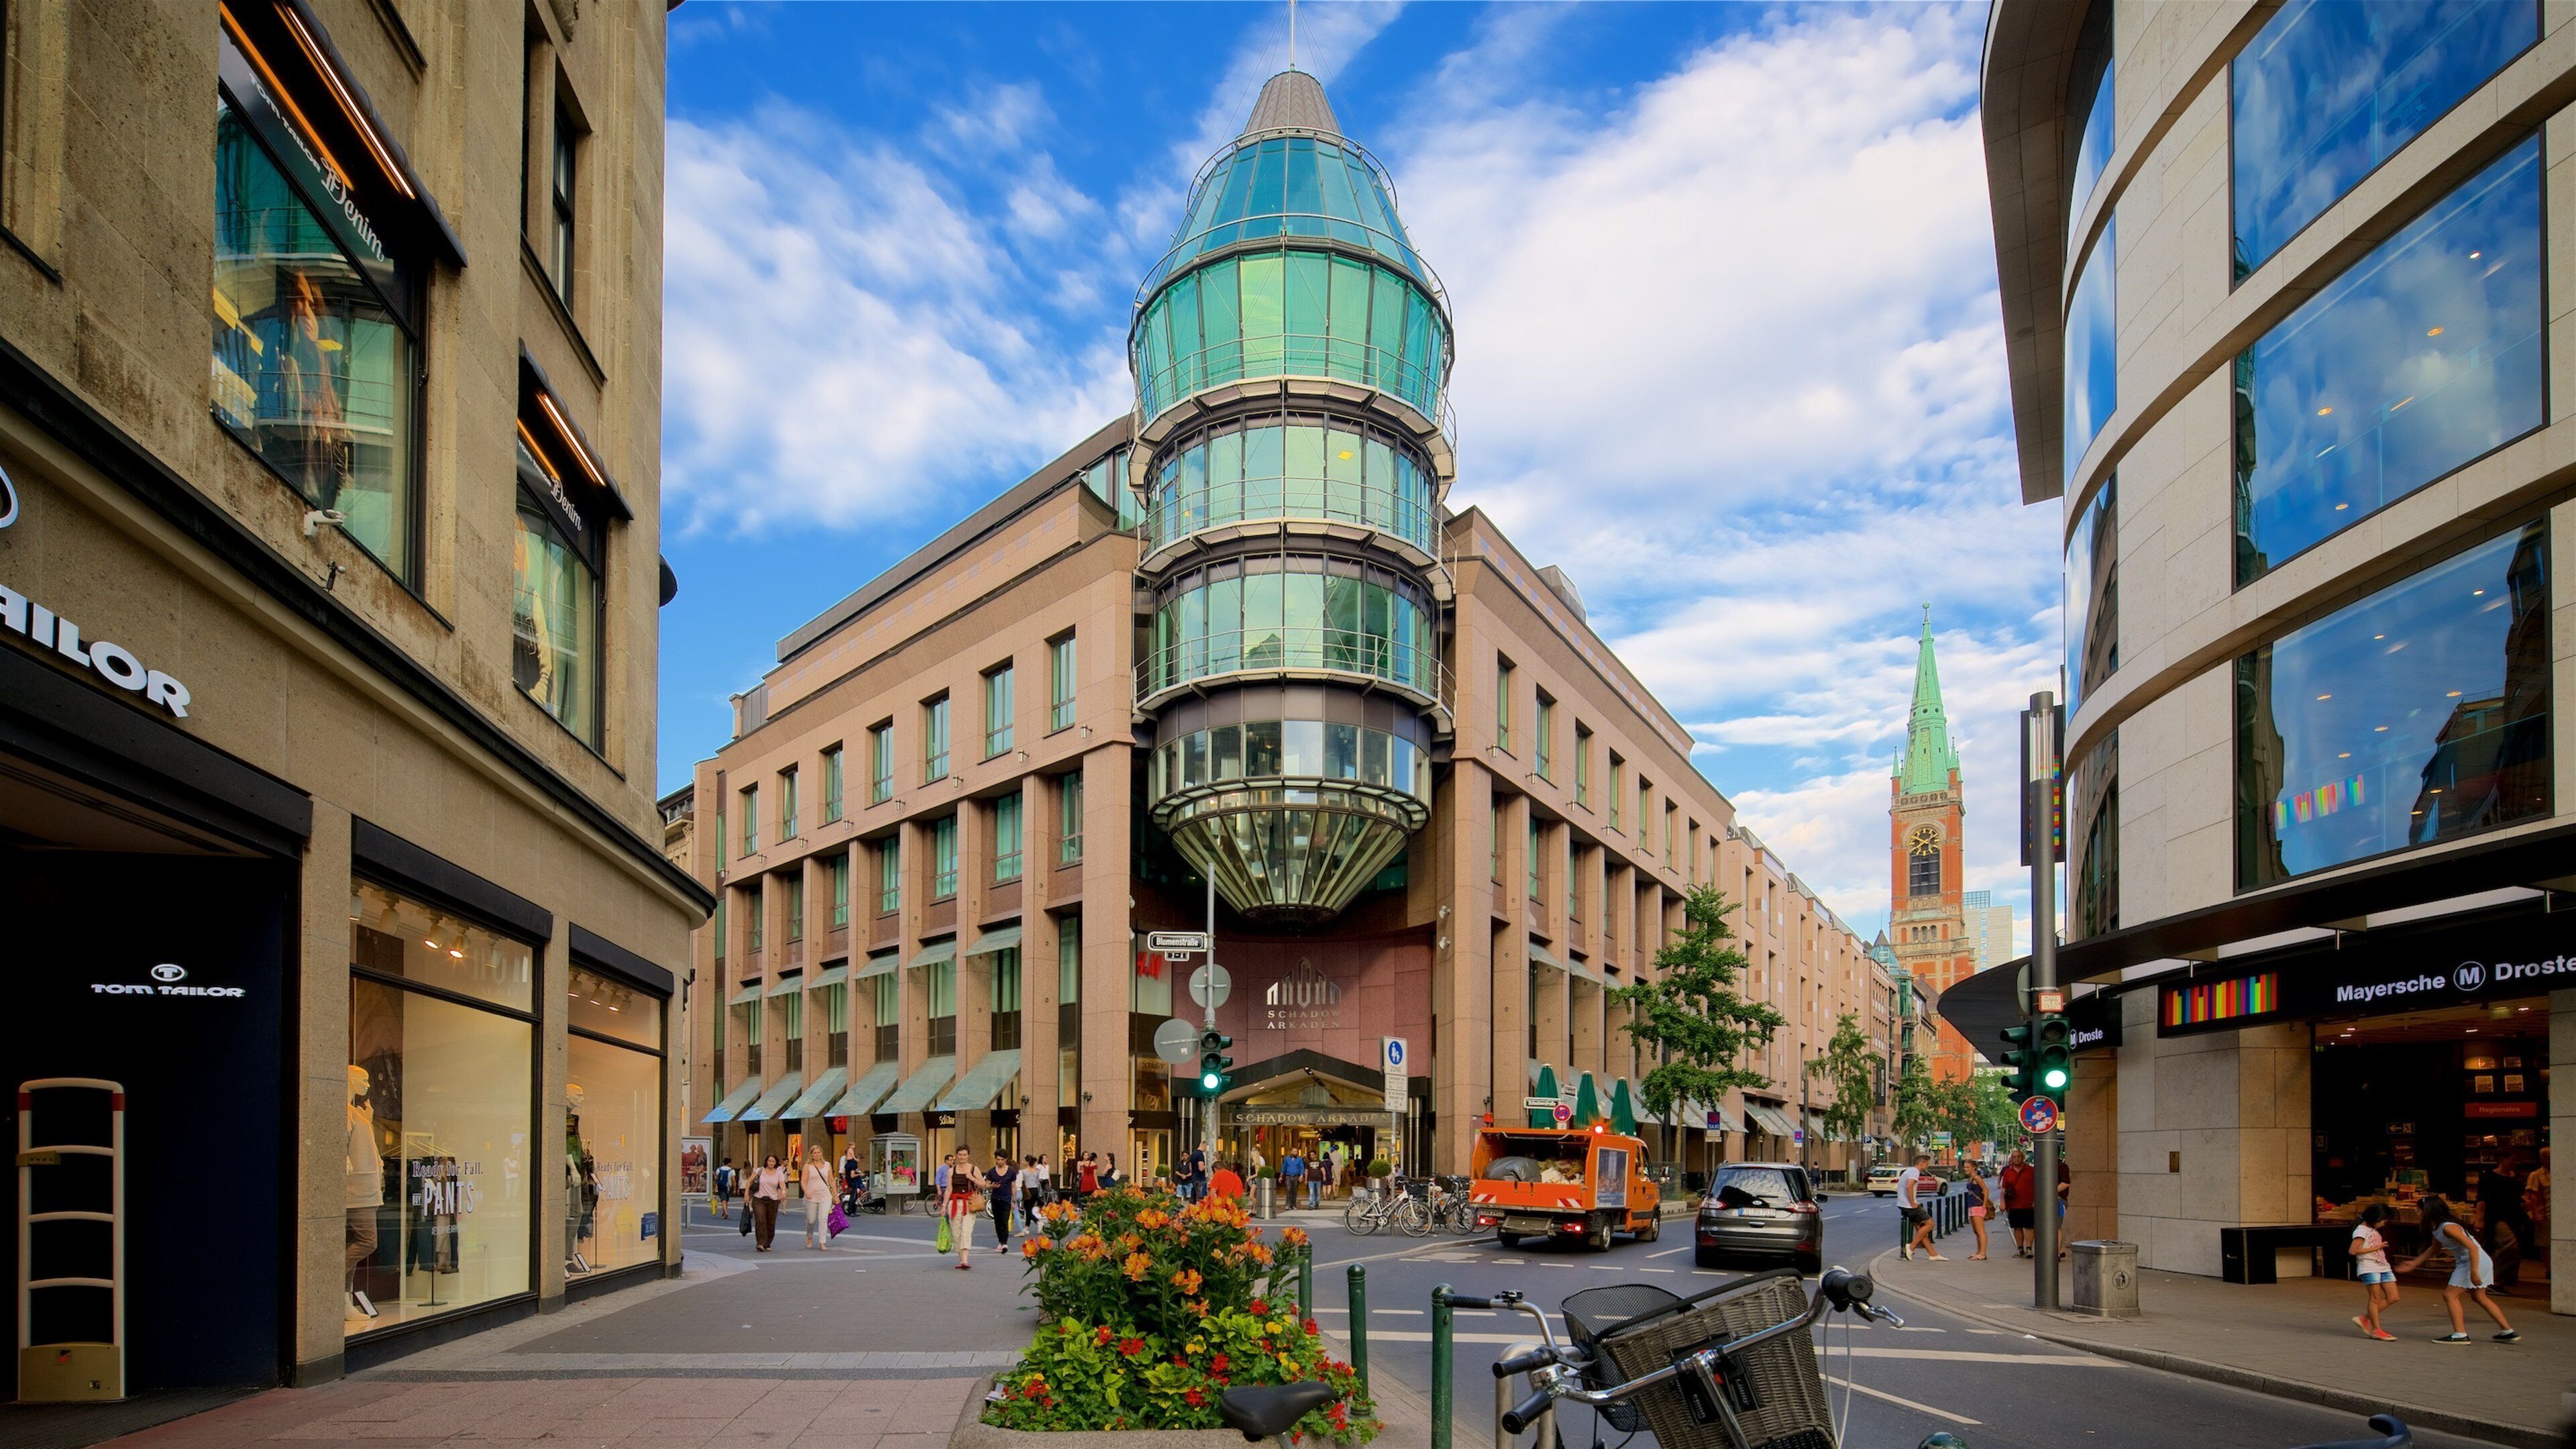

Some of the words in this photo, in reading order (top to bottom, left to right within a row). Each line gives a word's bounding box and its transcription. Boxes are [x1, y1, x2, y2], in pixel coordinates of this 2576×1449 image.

[250, 72, 280, 119] TOM
[280, 116, 321, 172] TAILOR
[321, 157, 384, 262] Denim
[551, 475, 582, 531] Denim
[1156, 936, 1199, 947] Blumenstraße
[2337, 975, 2446, 1002] Mayersche
[2495, 955, 2576, 981] Droste
[91, 983, 154, 994] TOM
[158, 986, 246, 998] TAILOR
[1268, 1010, 1339, 1018] SCHADOW
[1267, 1021, 1339, 1029] ARKADEN
[2079, 1028, 2103, 1043] Droste
[1236, 1114, 1307, 1123] SCHADOW
[412, 1161, 443, 1180] Ready
[446, 1161, 460, 1176] for
[464, 1162, 483, 1175] Fall.
[597, 1161, 612, 1174] Ready
[424, 1181, 474, 1216] PANTS
